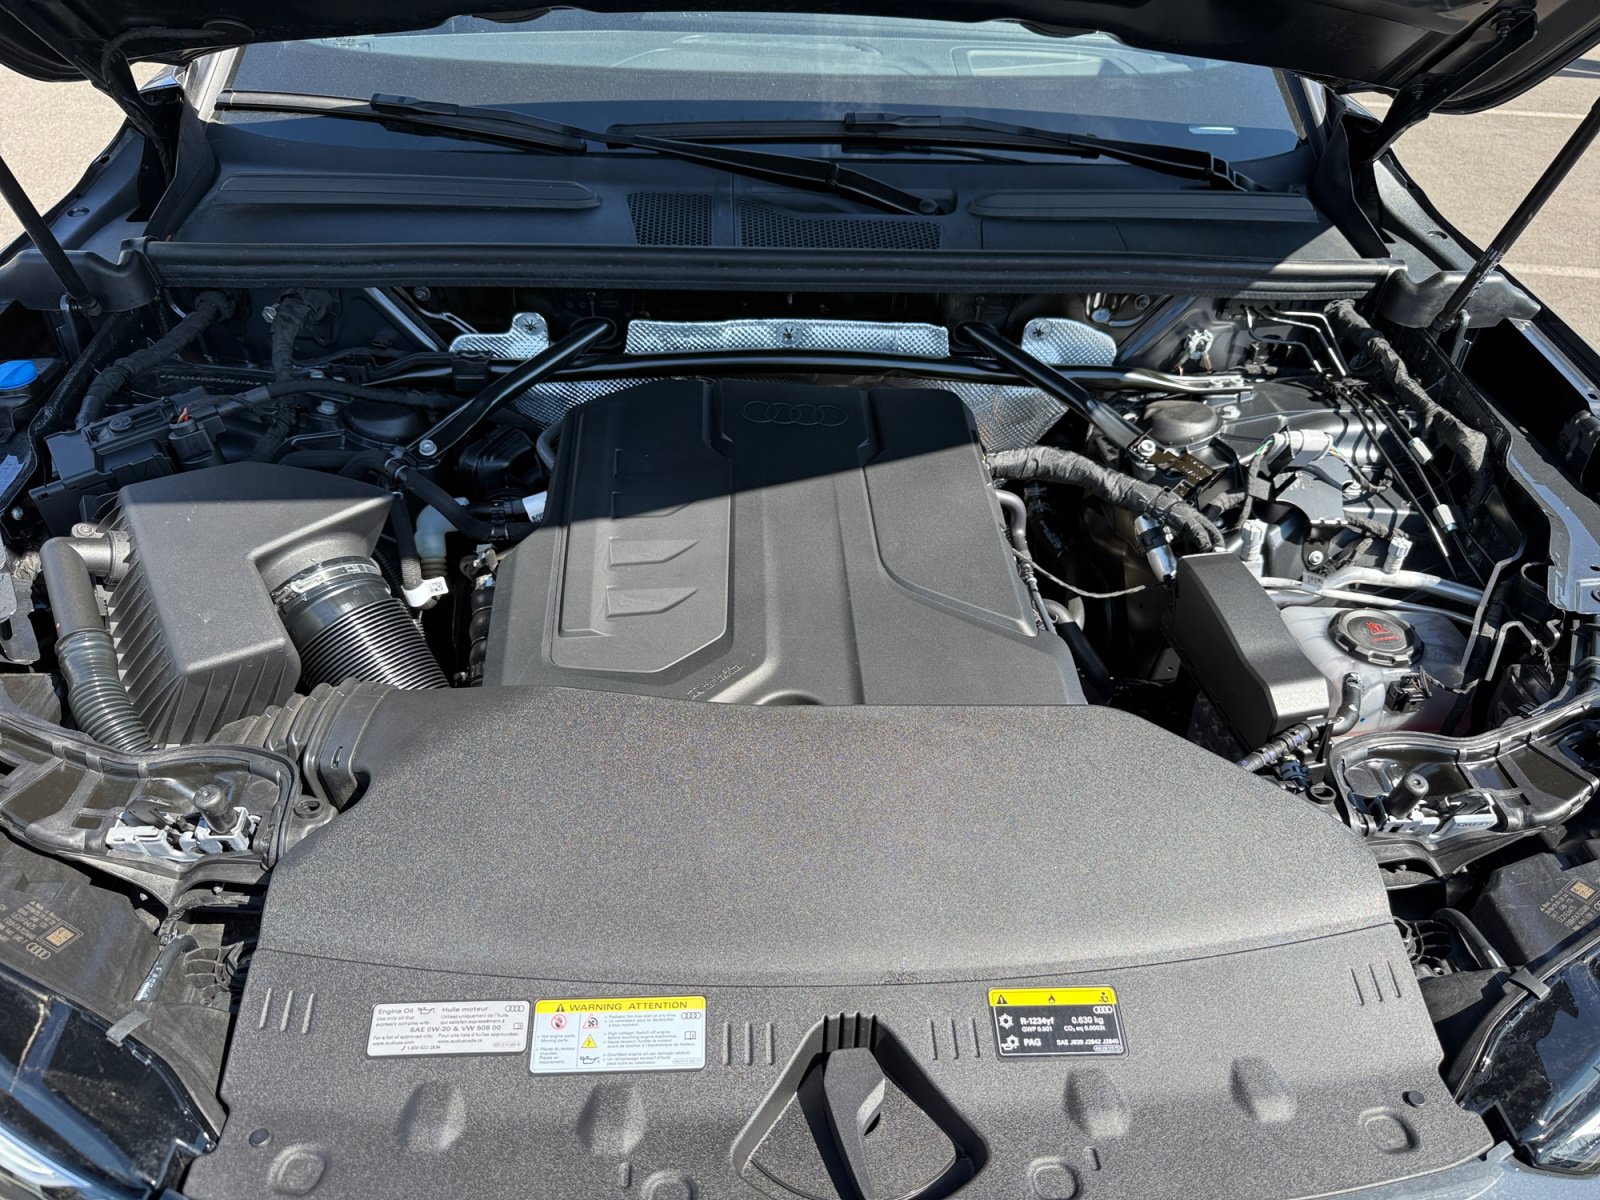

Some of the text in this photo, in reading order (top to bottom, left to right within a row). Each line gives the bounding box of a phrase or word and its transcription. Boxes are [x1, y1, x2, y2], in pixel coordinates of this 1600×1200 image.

[569, 1001, 687, 1011] WARNING ATTENTION
[1020, 1016, 1054, 1025] R-1234yf
[1094, 1016, 1104, 1025] kg
[1023, 1038, 1042, 1046] PAG
